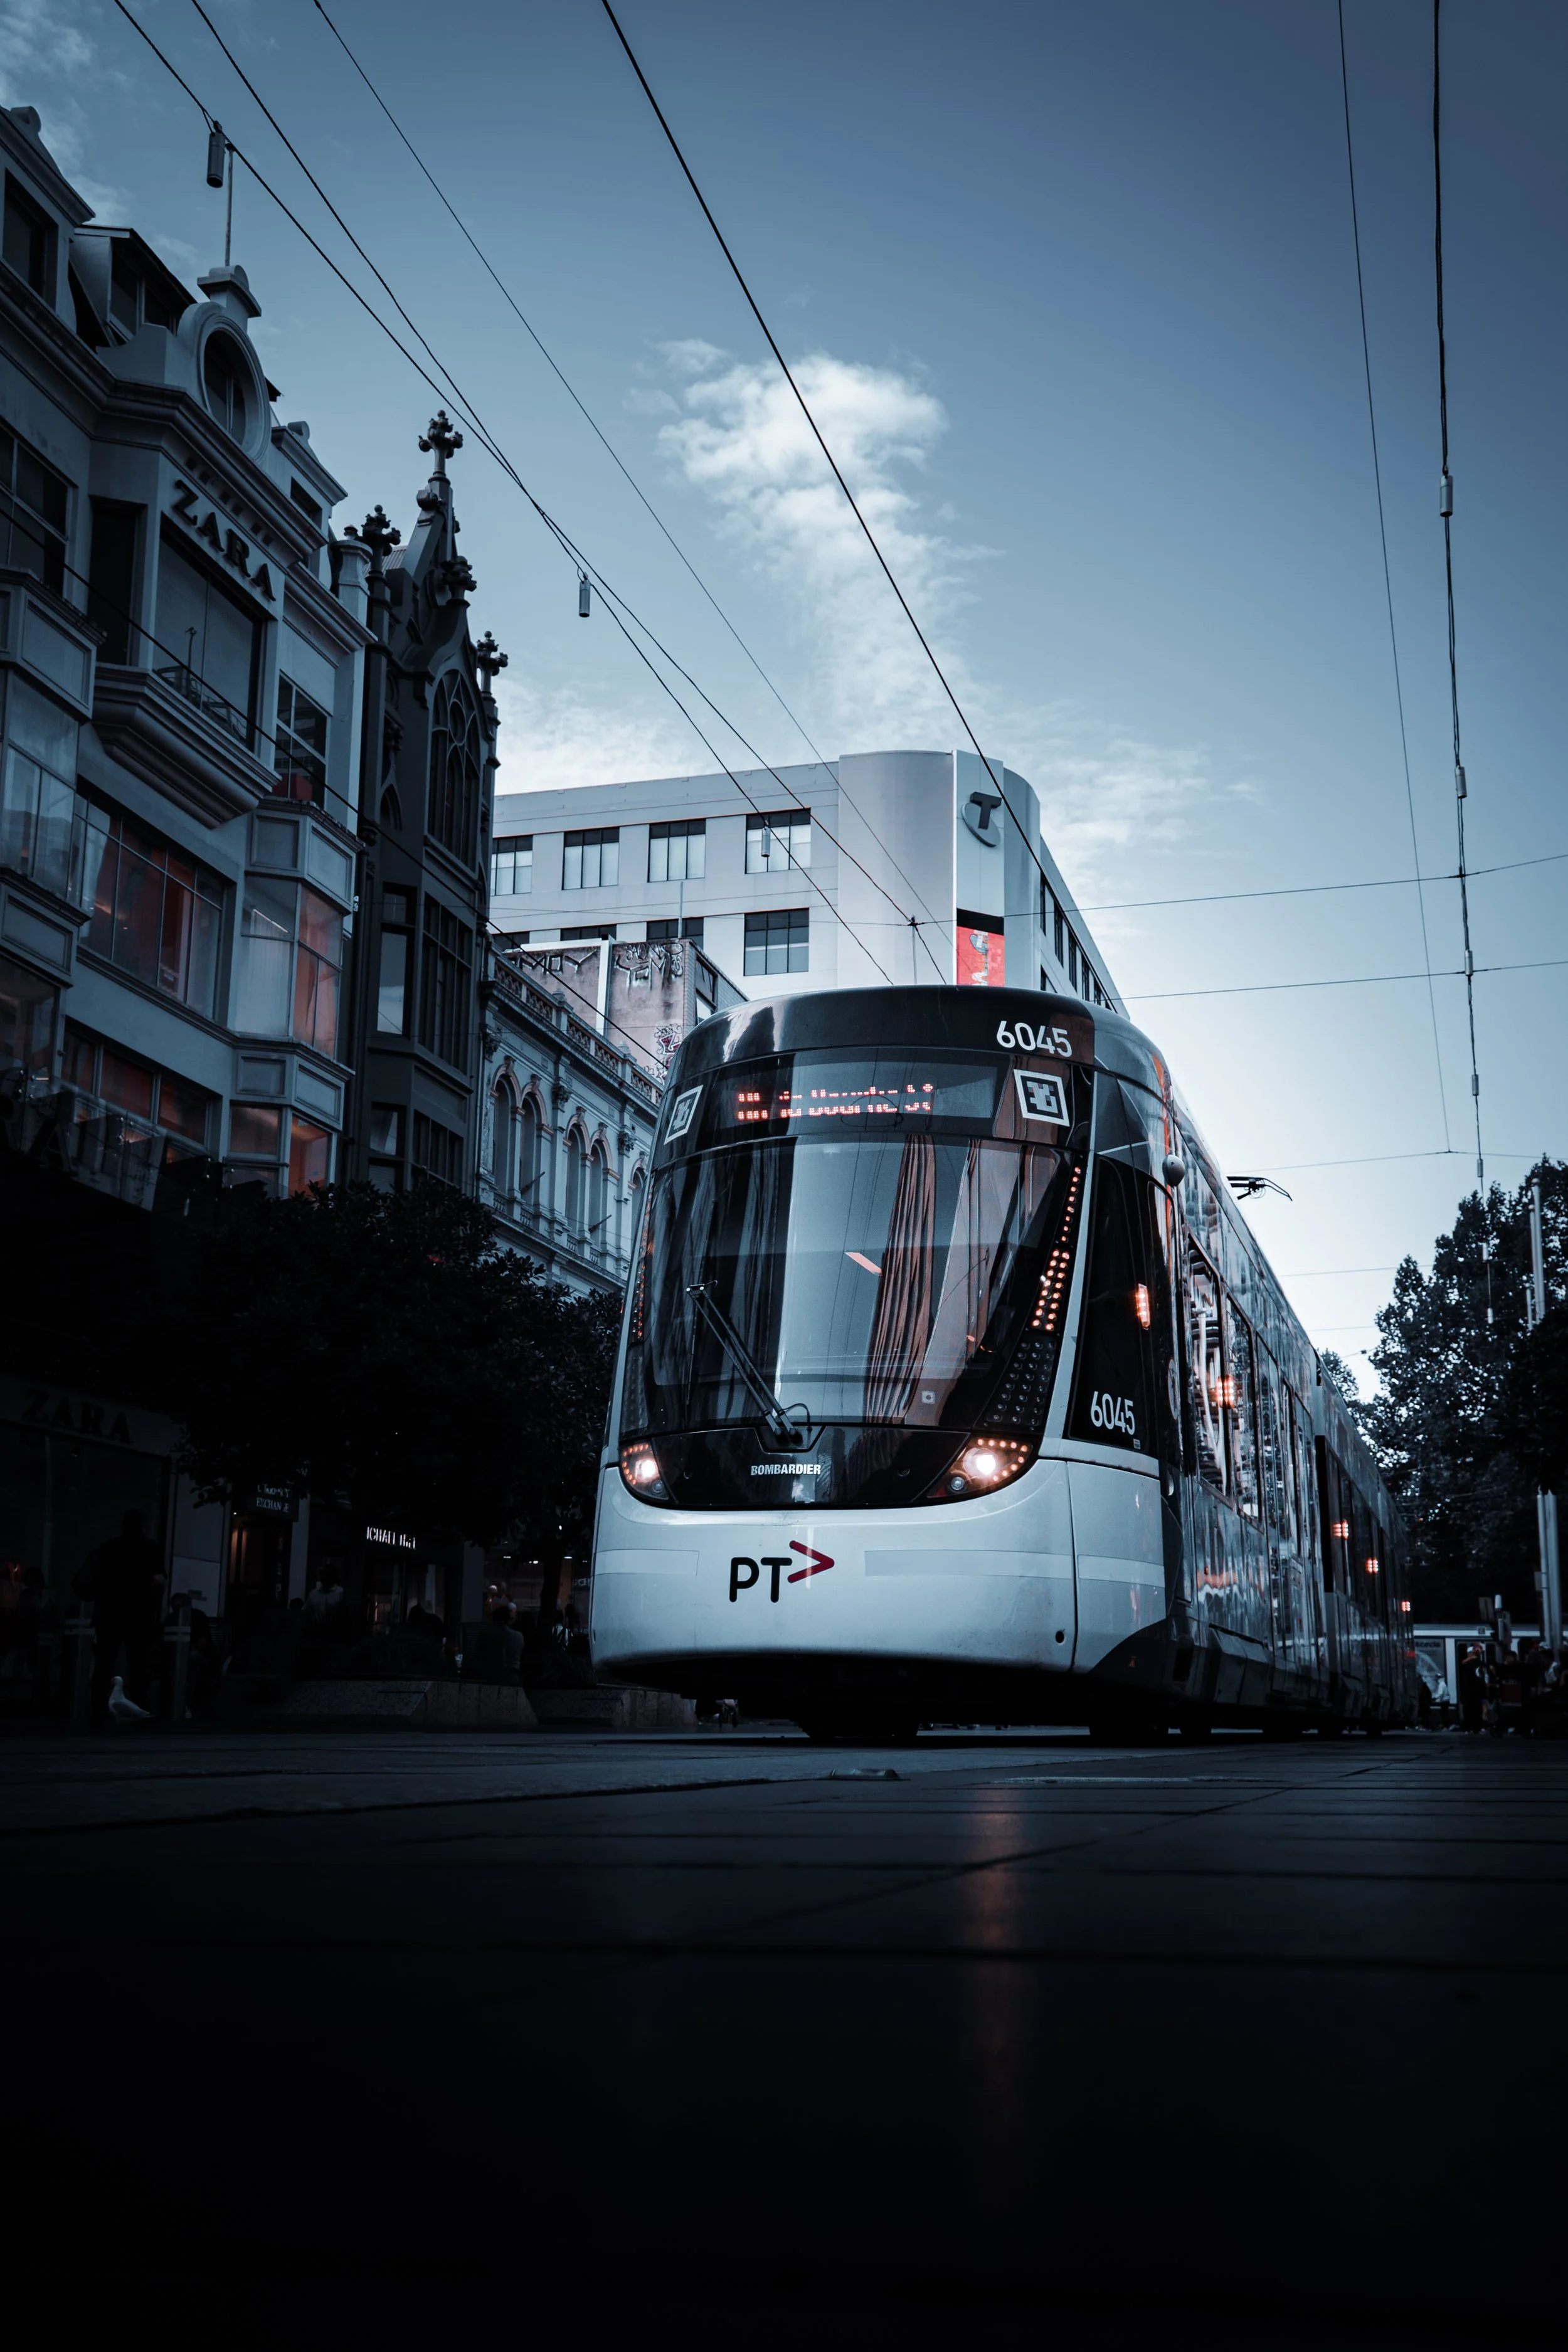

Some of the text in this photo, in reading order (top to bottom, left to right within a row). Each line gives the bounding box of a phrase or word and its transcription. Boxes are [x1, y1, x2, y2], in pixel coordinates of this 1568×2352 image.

[171, 479, 277, 602] ZARA
[997, 1020, 1073, 1057] 6045
[23, 1387, 133, 1444] ZARA
[1091, 1391, 1135, 1435] 6045
[751, 1464, 822, 1476] BOMBARDIER
